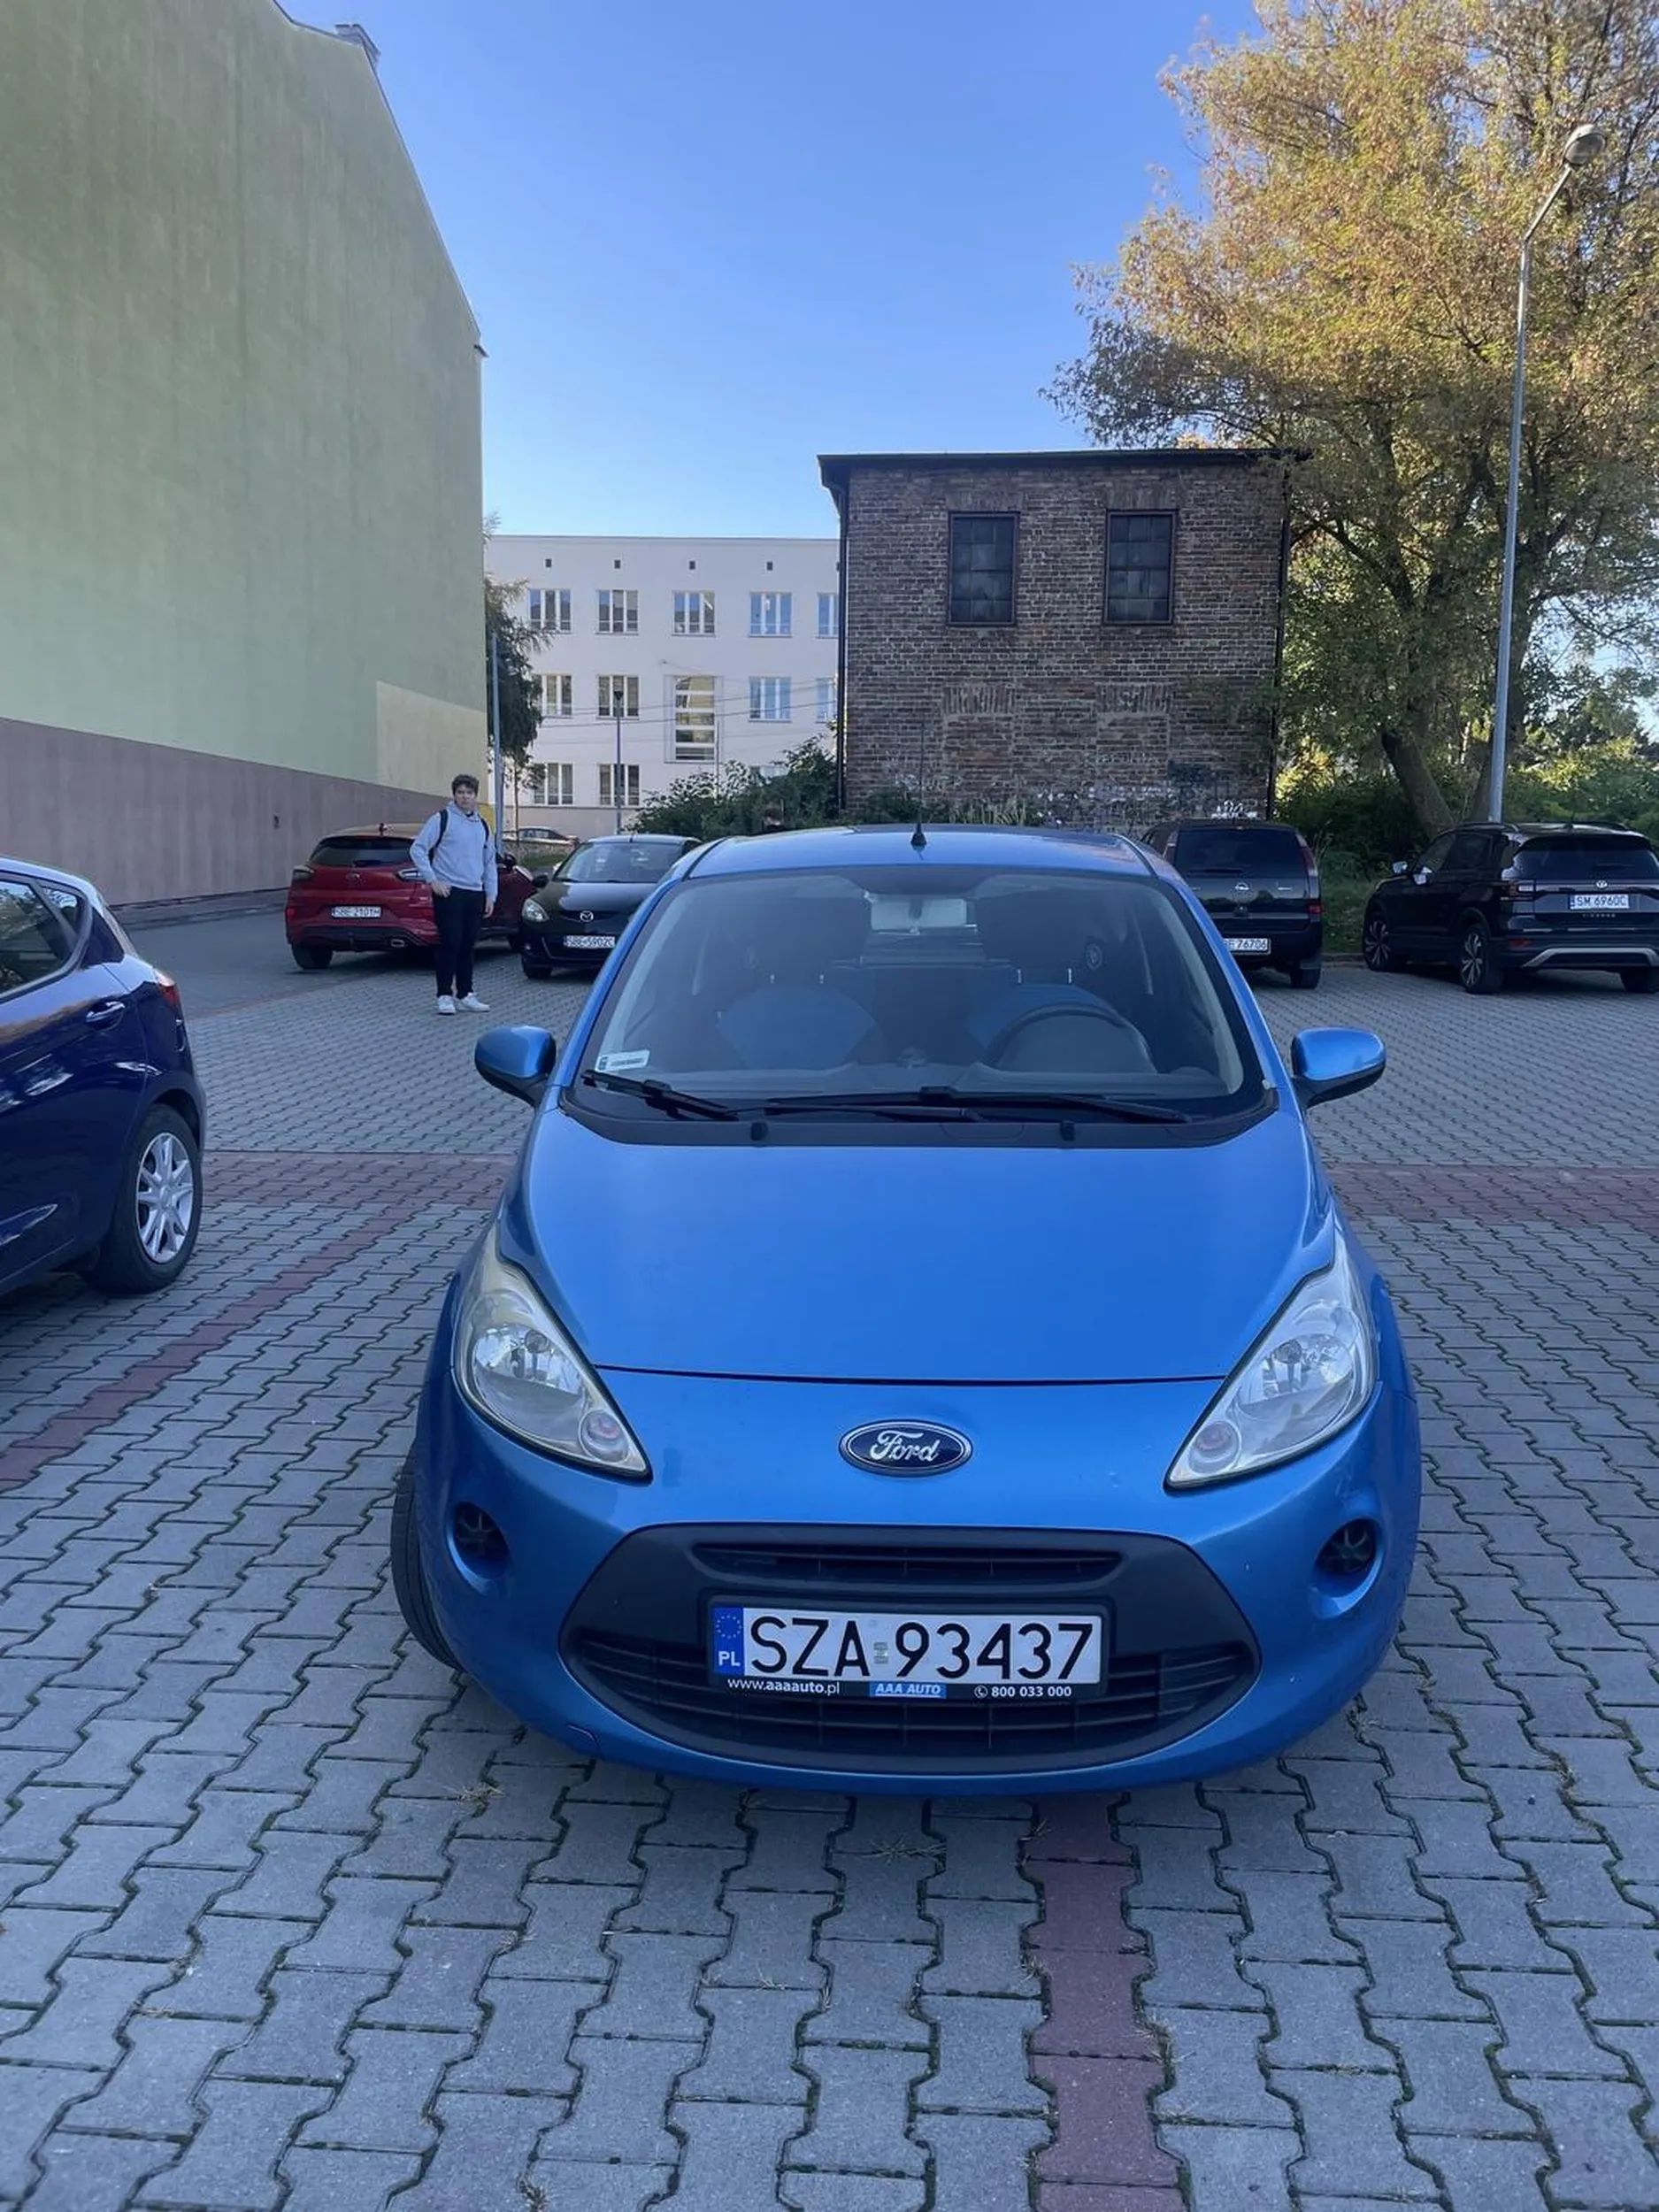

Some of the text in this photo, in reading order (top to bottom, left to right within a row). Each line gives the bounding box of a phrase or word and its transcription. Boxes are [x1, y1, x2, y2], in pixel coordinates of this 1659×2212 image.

[1577, 895, 1591, 907] SM
[870, 1430, 941, 1462] Ford
[750, 1615, 1094, 1681] SZA 93437
[718, 1650, 741, 1667] PL
[726, 1678, 840, 1696] www.aaaauto.pl
[875, 1683, 942, 1696] AAA AUTO
[991, 1686, 1071, 1698] 800 033 000
